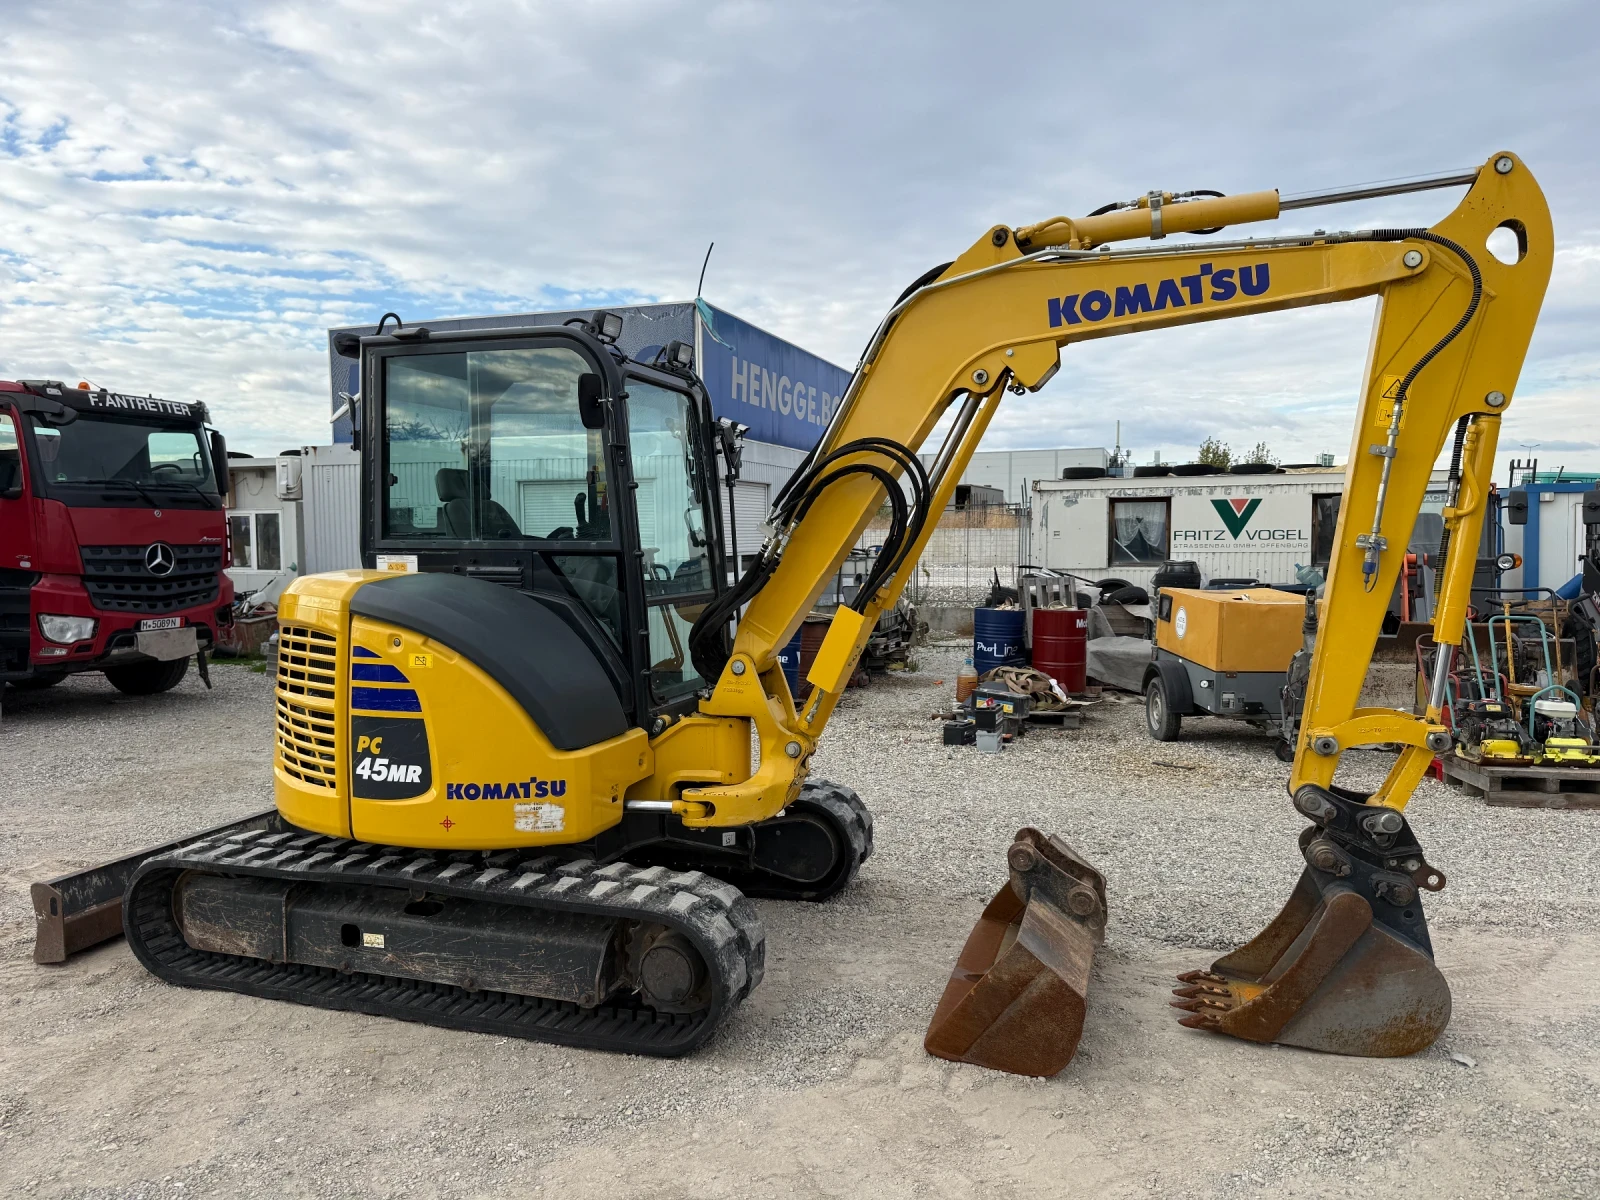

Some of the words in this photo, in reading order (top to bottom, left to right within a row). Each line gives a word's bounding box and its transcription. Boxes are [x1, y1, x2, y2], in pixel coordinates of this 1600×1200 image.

[1047, 263, 1271, 329] KOMATSU
[105, 395, 192, 417] ANTRETTER
[1173, 530, 1226, 541] FRITZ
[1246, 529, 1309, 541] VOGEL
[356, 735, 383, 755] PC
[355, 756, 422, 783] 45MR
[446, 776, 566, 800] KOMATSU
